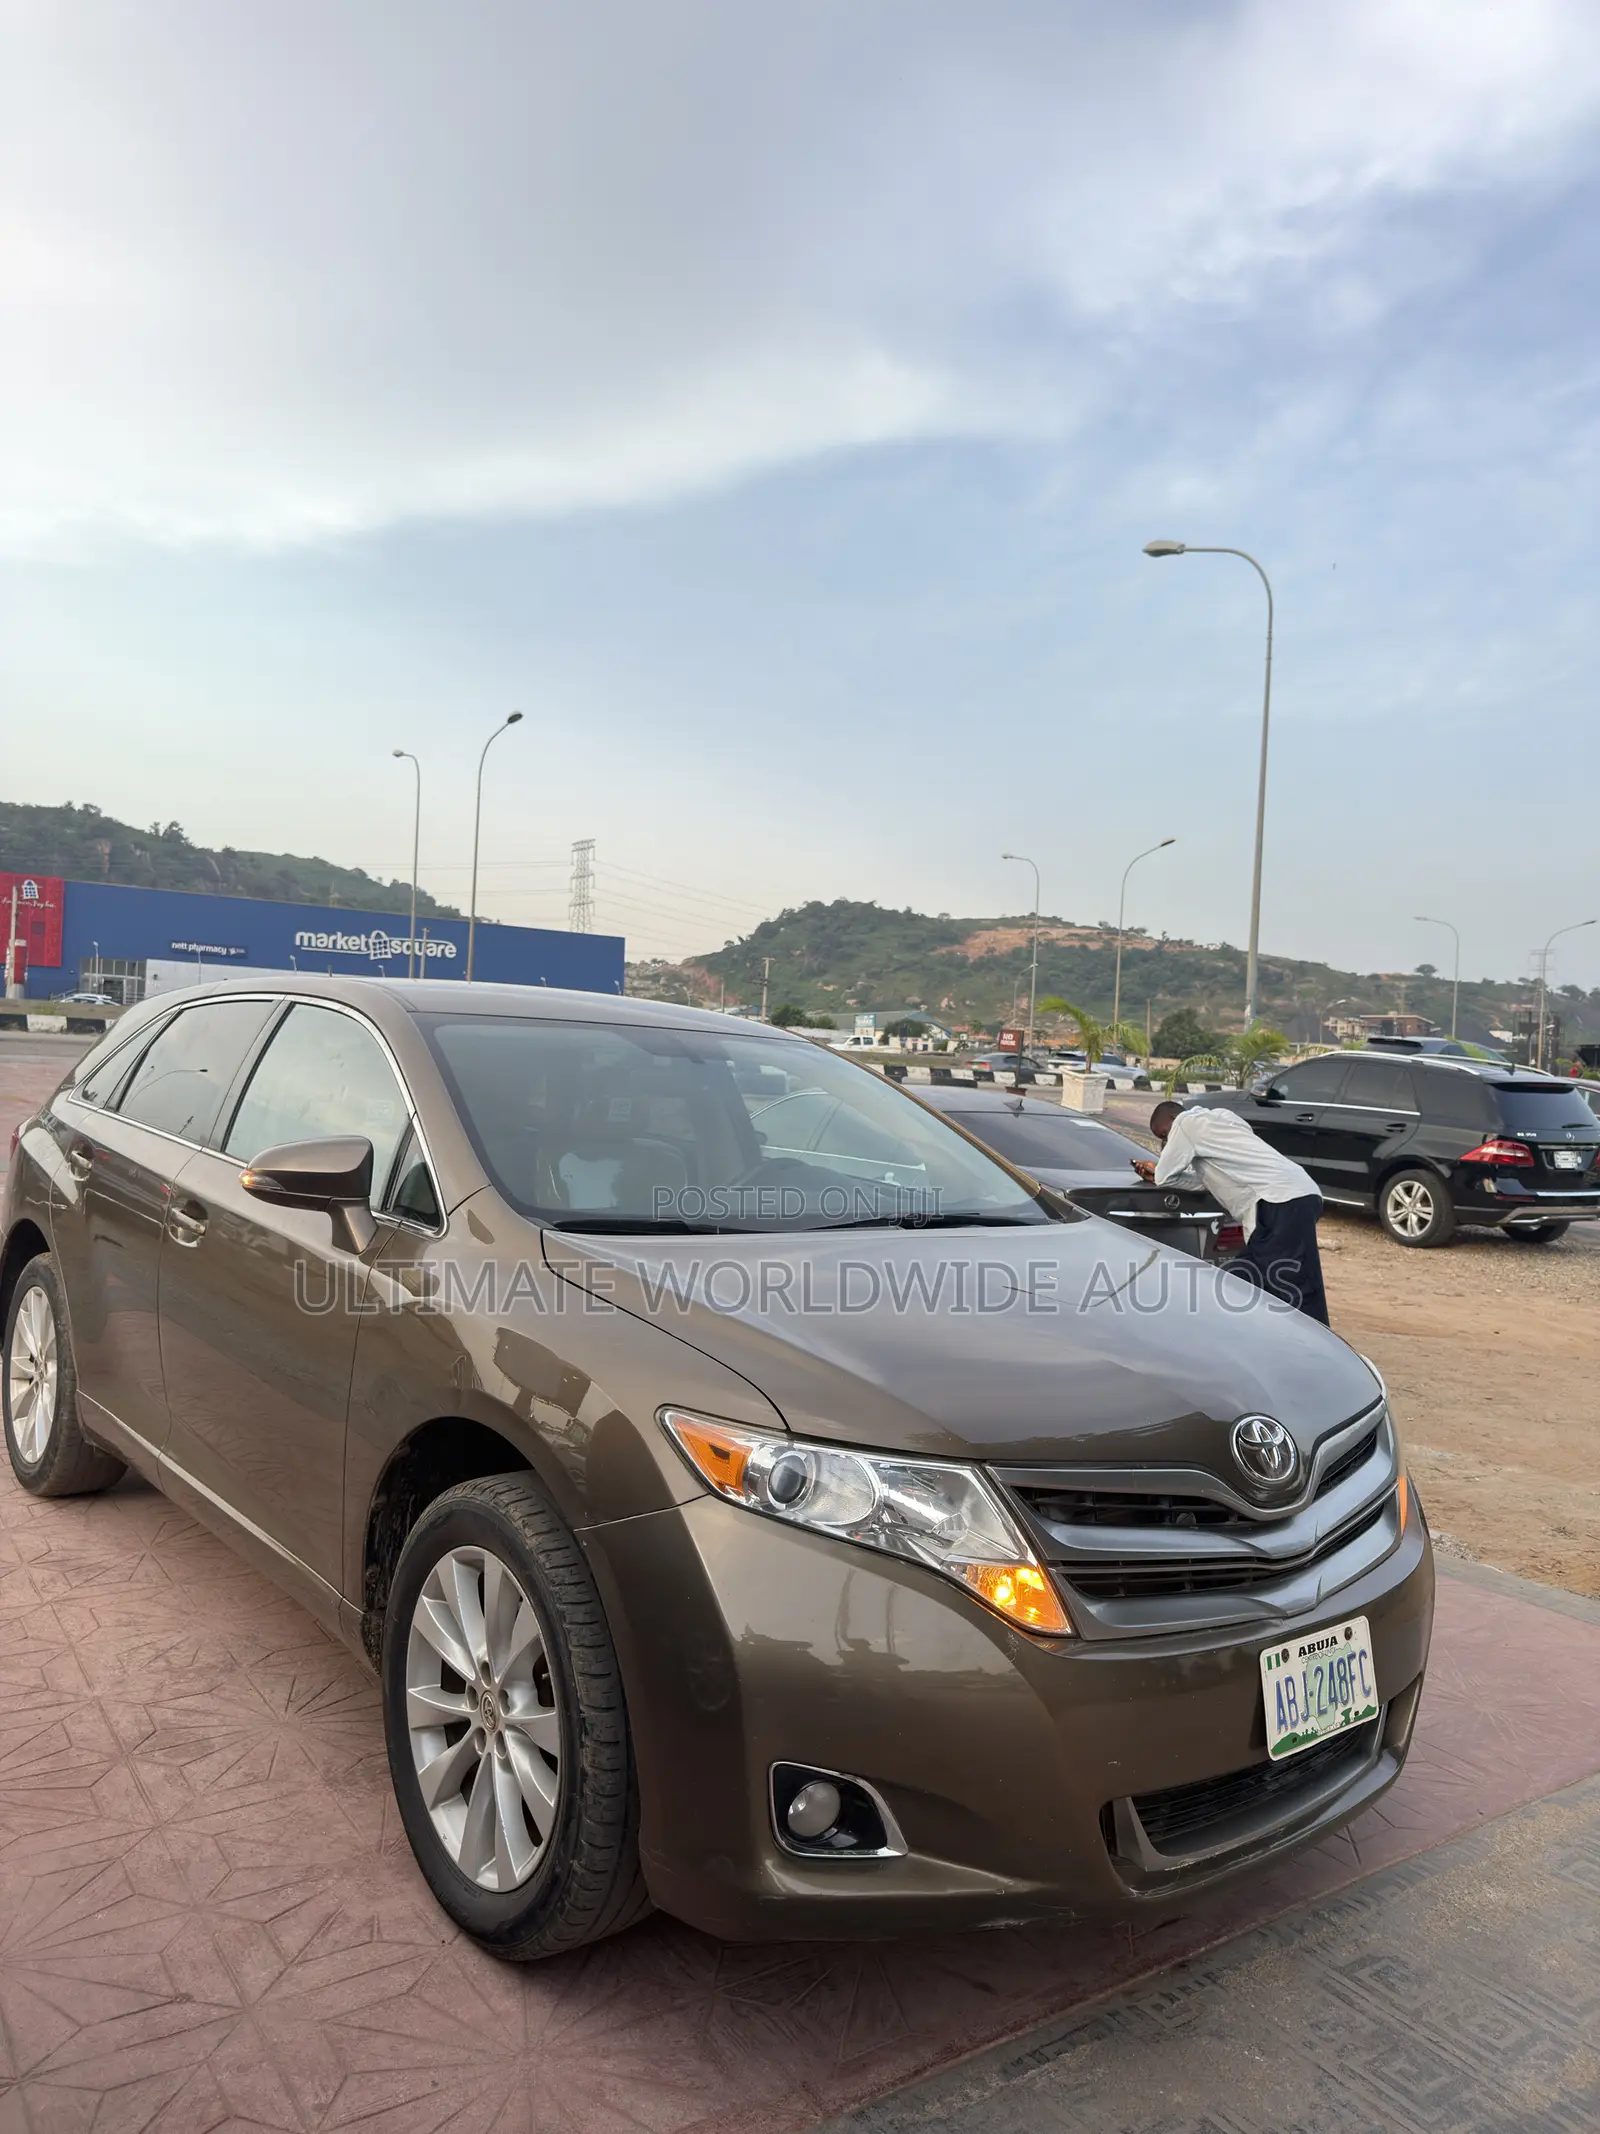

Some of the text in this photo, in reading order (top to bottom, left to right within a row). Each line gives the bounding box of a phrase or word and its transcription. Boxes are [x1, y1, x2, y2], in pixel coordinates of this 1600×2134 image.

[188, 943, 227, 955] pharmacy
[295, 931, 457, 958] market square
[1298, 1635, 1338, 1657] ABUJA
